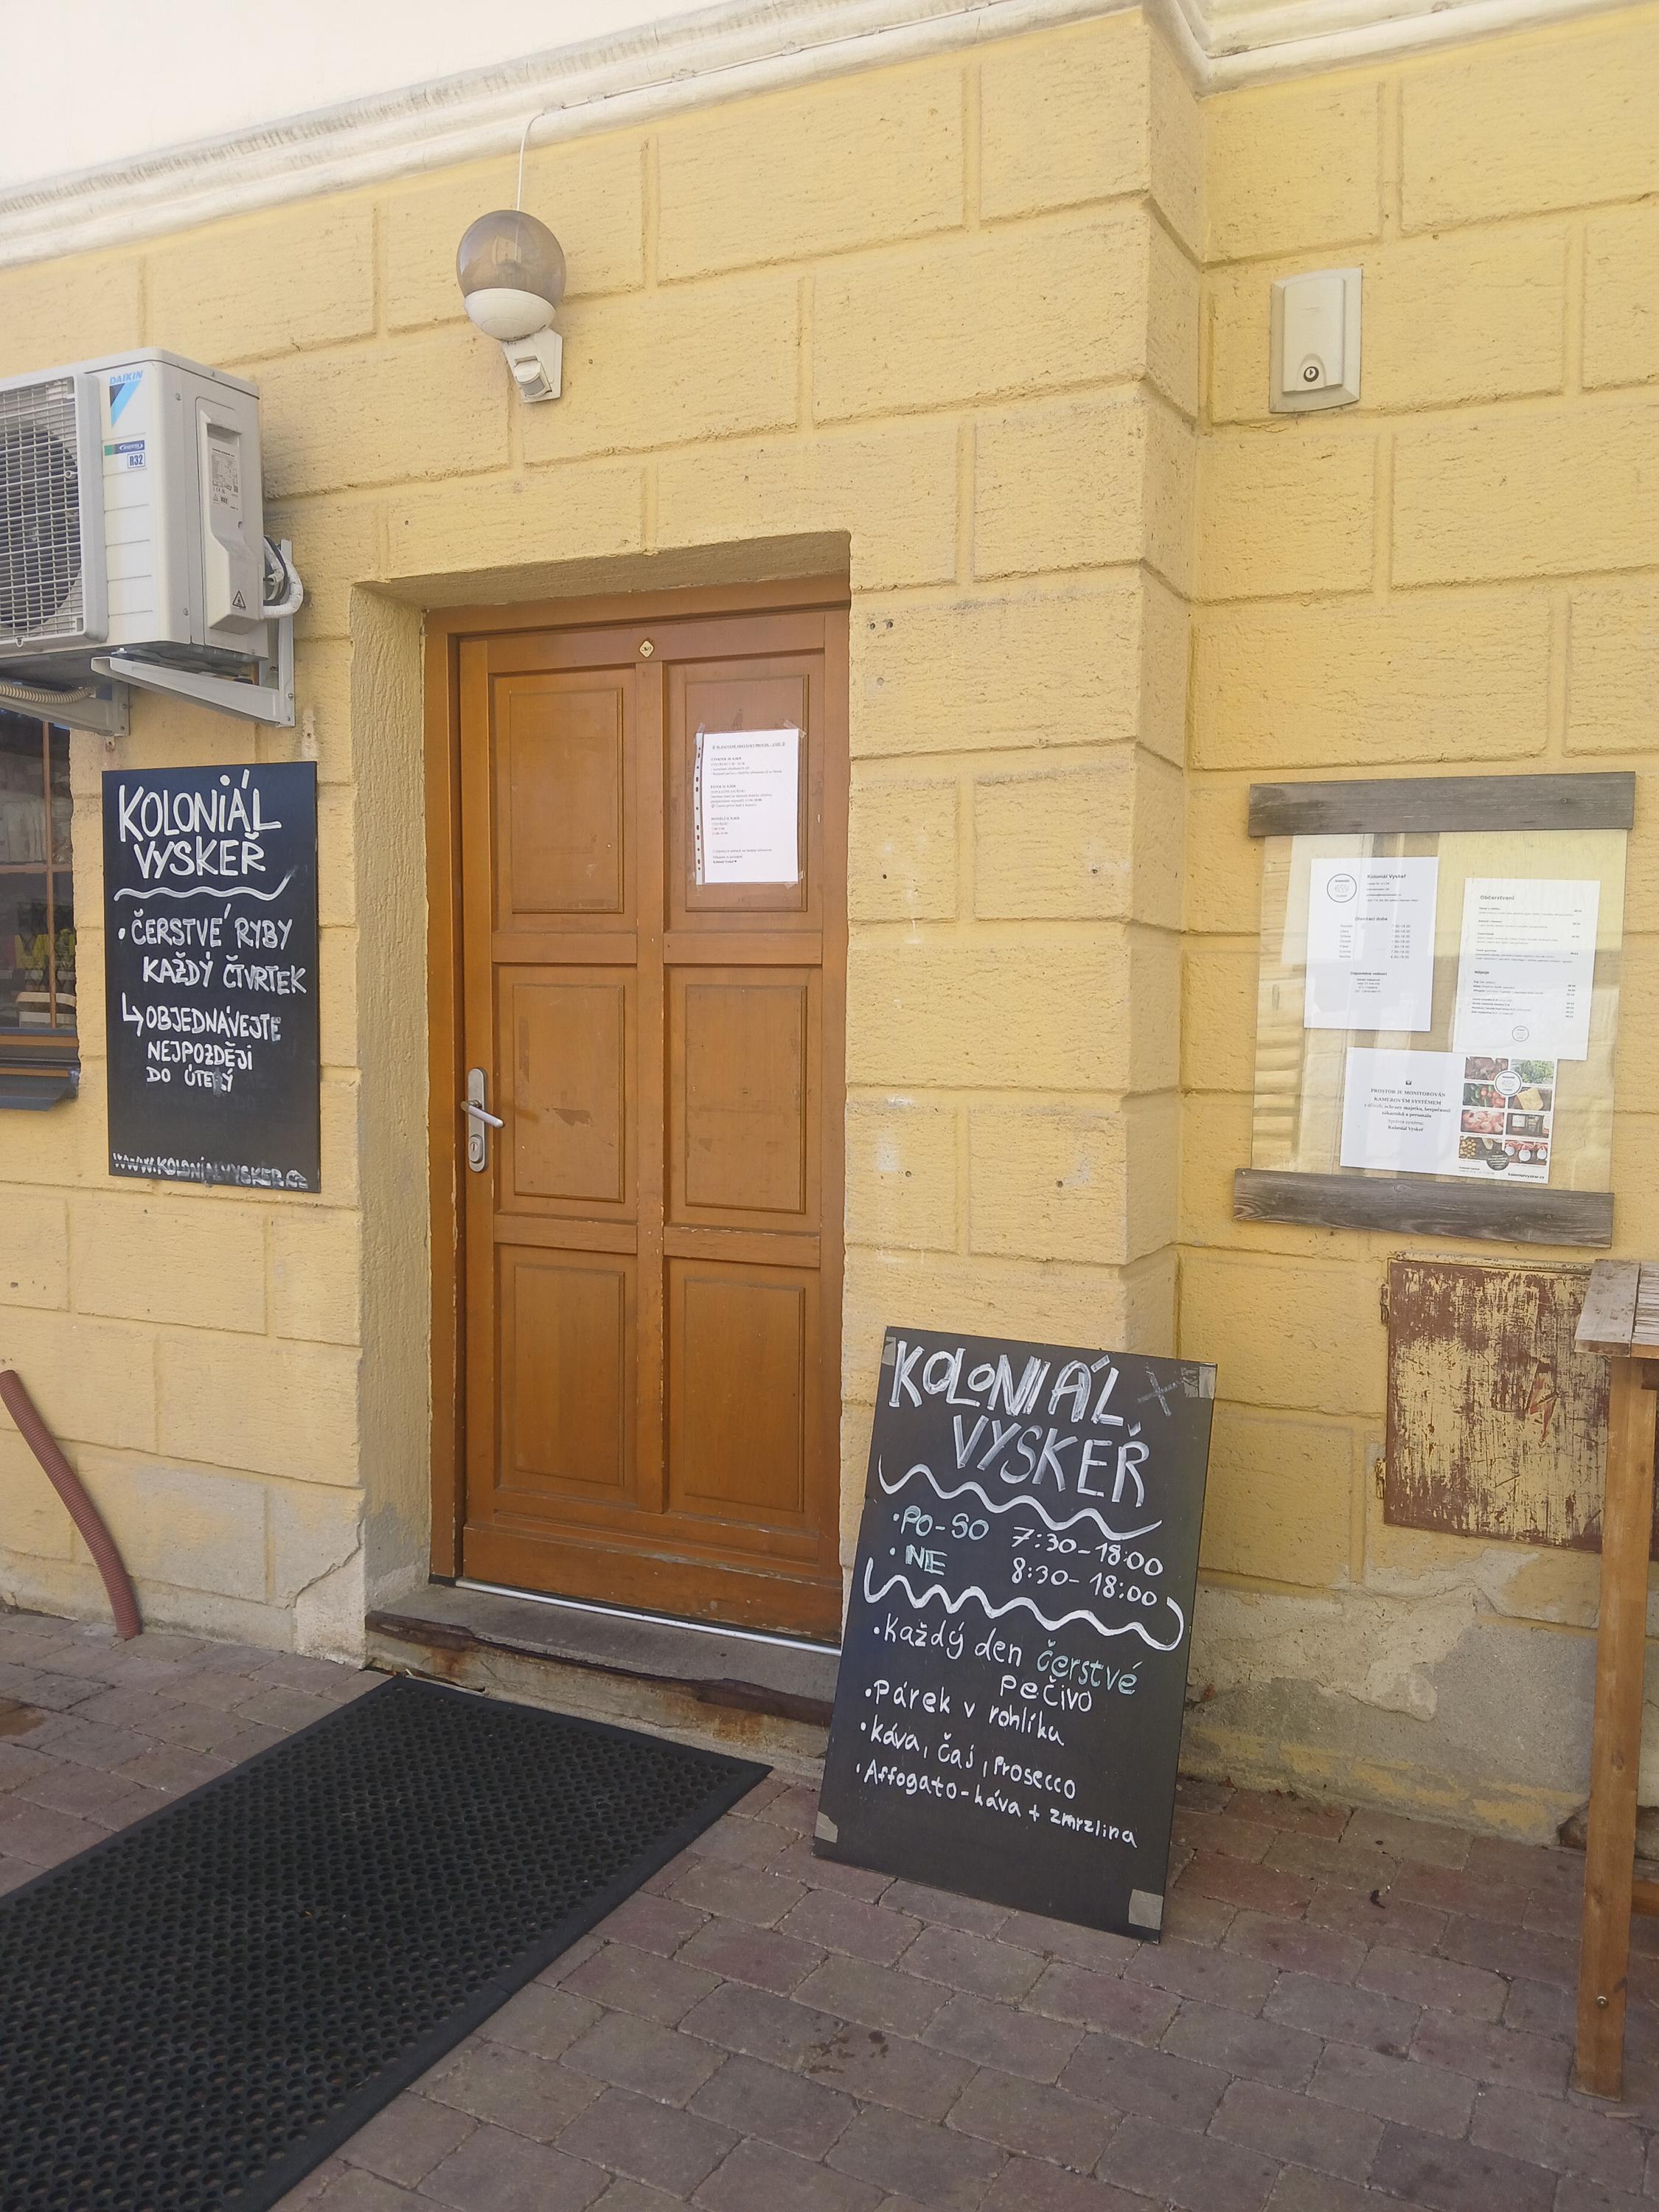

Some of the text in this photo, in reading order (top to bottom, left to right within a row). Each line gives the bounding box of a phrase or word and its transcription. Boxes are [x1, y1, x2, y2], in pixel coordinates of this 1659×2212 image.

[110, 370, 143, 384] DAIKIN
[129, 454, 143, 466] R32
[133, 831, 266, 880] VYSKEŘ
[131, 903, 293, 950] ČERSTVÉ RYBY
[142, 950, 307, 995] KAŽDÝ ČTVRTEK
[145, 1005, 282, 1042] OBJEDNÁVEJTE
[146, 1065, 171, 1083] DO
[953, 1421, 1150, 1508] VYSKEŘ
[905, 1543, 949, 1576] NE
[974, 1627, 1023, 1667] den
[873, 1679, 1065, 1747] Párek v rohlíku
[1049, 1806, 1138, 1849] zmrzlina
